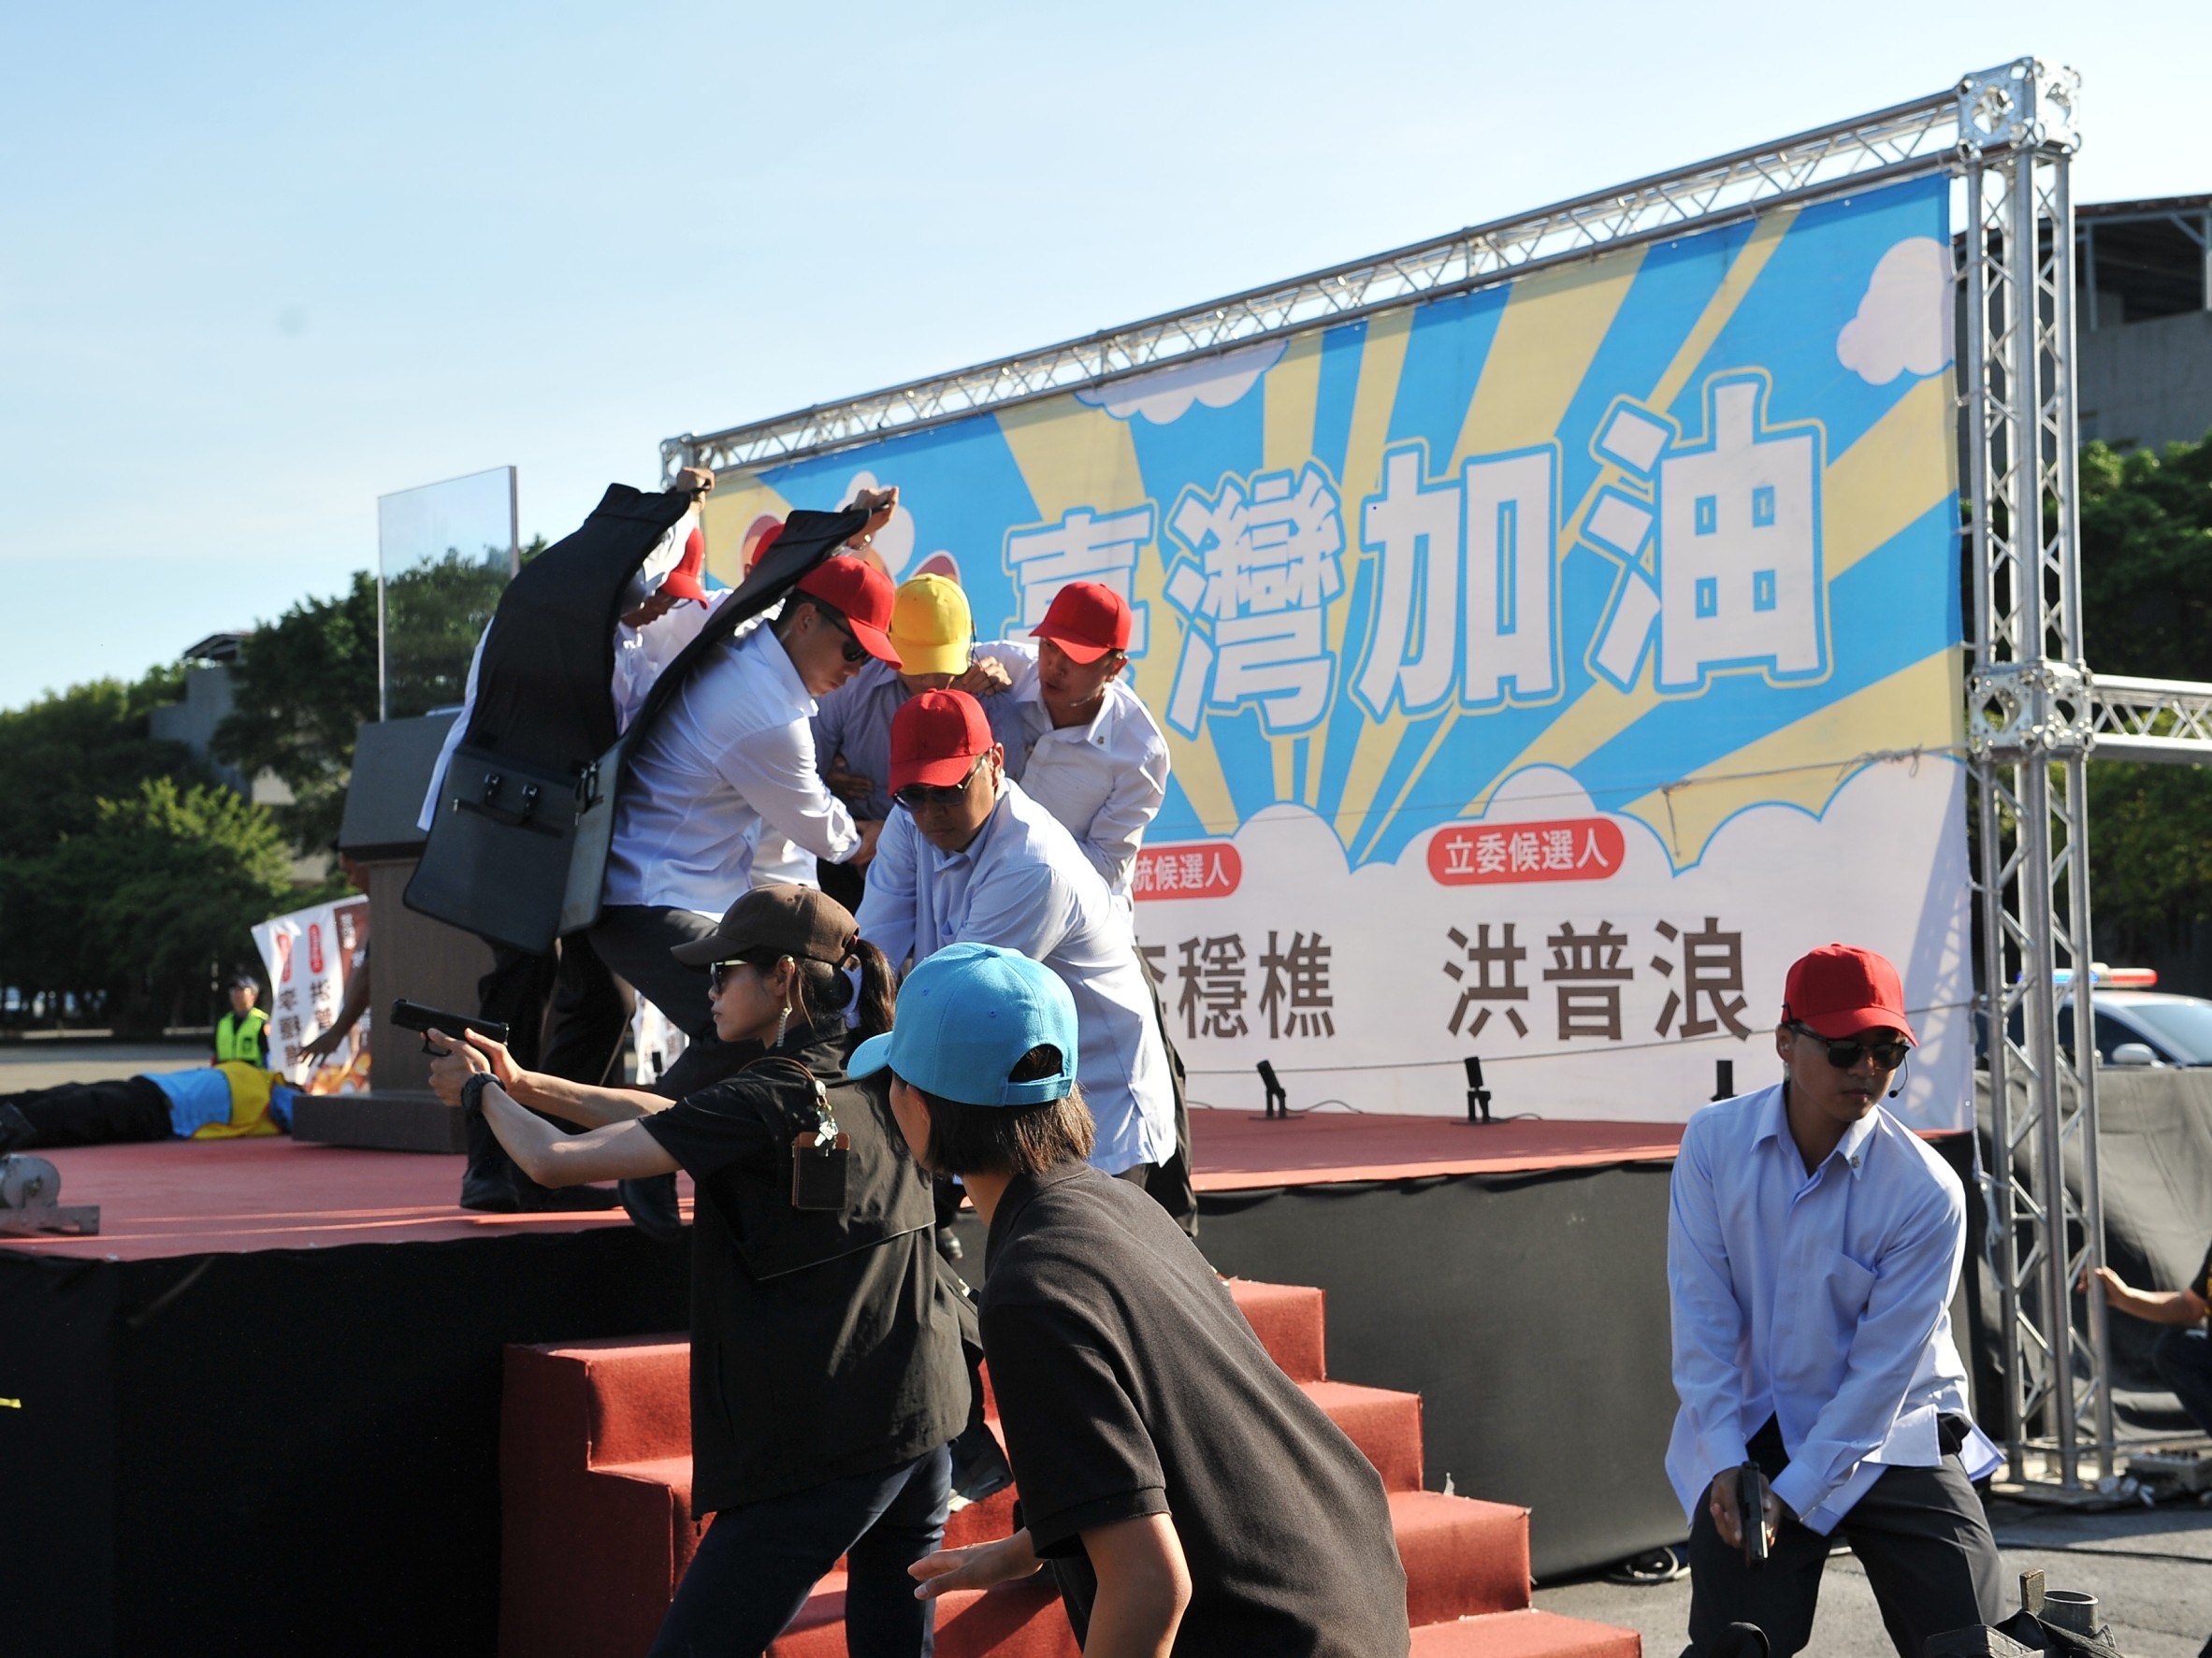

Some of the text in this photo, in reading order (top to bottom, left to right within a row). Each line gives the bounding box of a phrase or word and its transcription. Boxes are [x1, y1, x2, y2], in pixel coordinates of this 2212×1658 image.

[1444, 827, 1610, 874] 立委候選人
[1443, 916, 1752, 1042] 洪普浪
